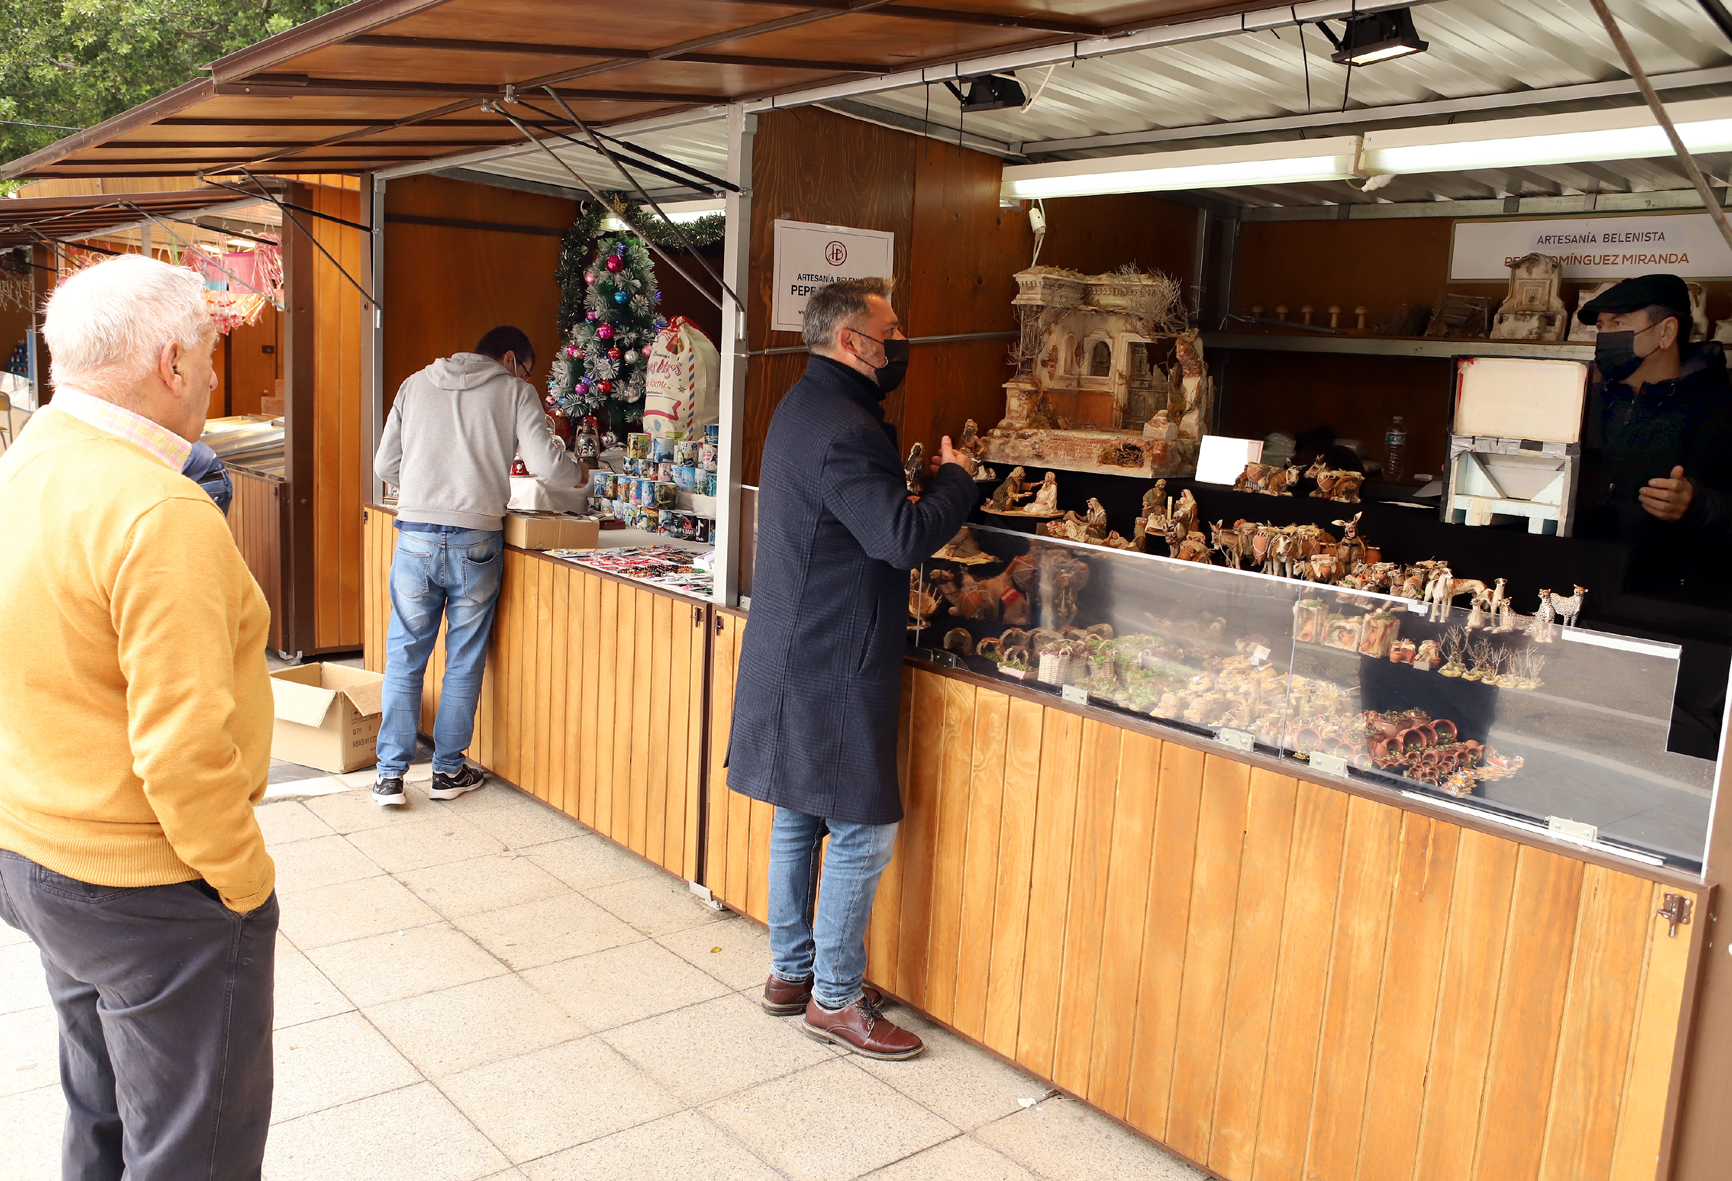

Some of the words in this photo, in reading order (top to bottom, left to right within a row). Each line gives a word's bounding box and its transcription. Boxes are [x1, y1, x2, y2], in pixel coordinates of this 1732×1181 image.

[1536, 232, 1597, 245] ARTESANÍA
[1602, 231, 1665, 243] BELENISTA
[1621, 252, 1690, 265] MIRANDA
[796, 273, 835, 283] ARTESANÍA
